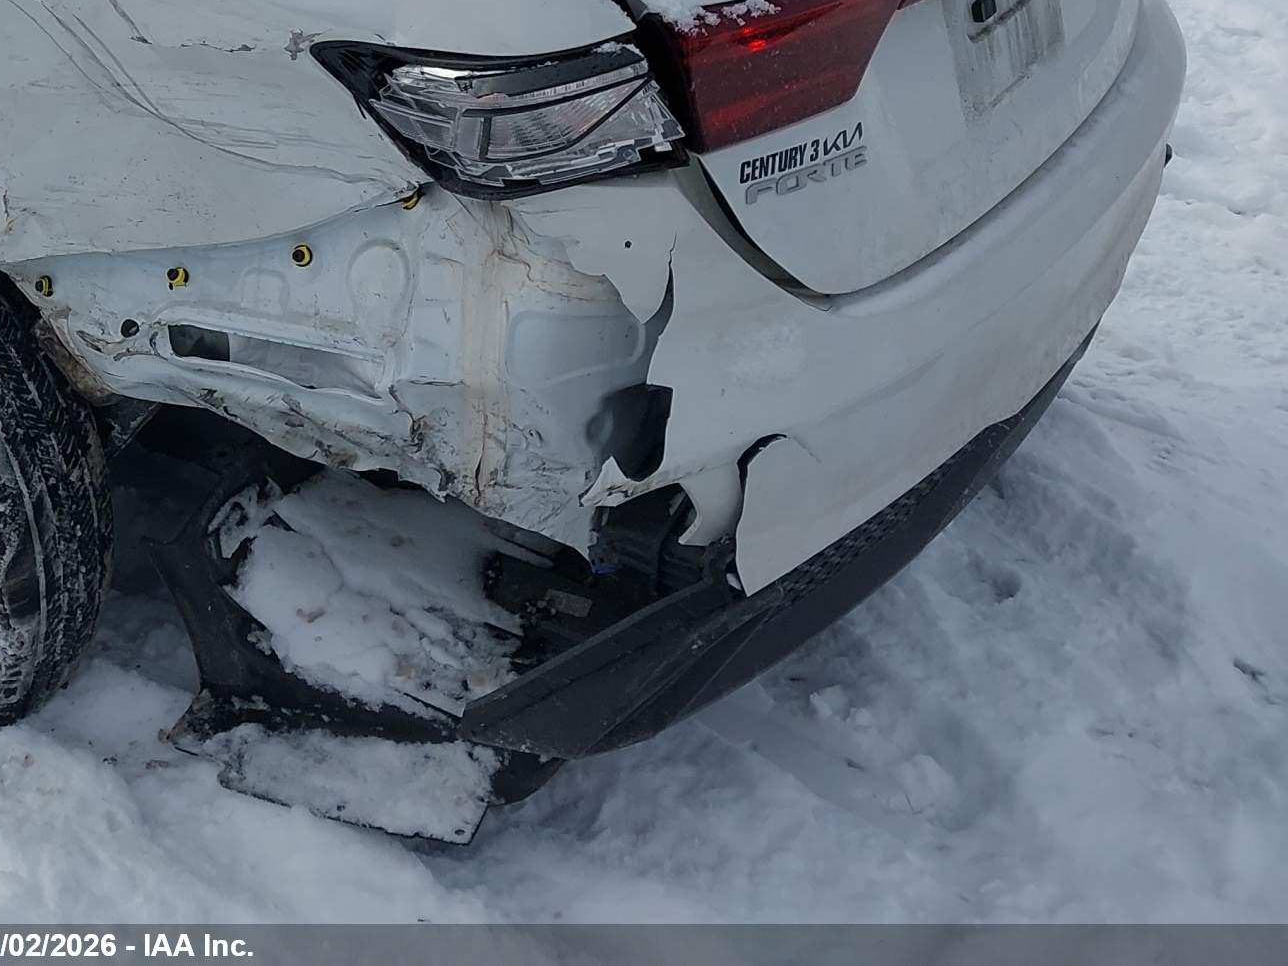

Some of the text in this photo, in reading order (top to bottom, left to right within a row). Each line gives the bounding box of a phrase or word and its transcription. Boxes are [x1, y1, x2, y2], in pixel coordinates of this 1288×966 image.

[739, 143, 808, 184] CENTURY
[810, 138, 820, 162] 3
[745, 145, 867, 205] FORTE
